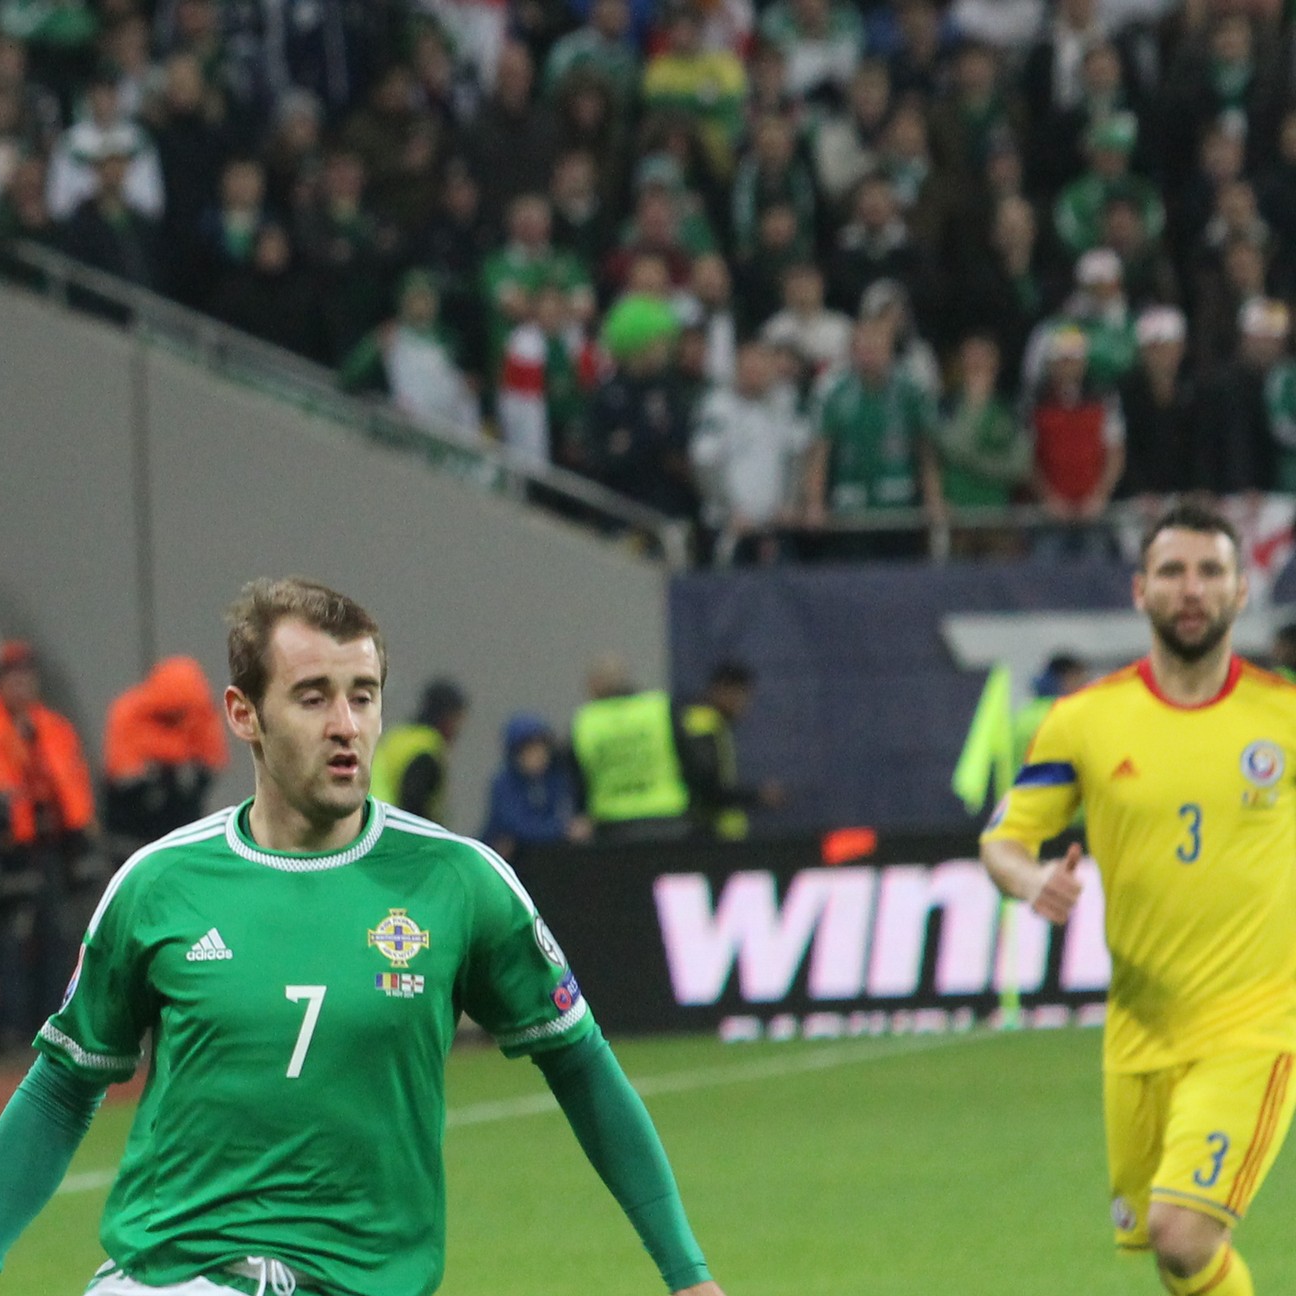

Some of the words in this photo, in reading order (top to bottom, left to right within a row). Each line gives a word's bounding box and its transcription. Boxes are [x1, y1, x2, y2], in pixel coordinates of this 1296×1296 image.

[1176, 803, 1202, 864] 3
[186, 949, 233, 961] adidas
[285, 985, 327, 1077] 7
[1194, 1132, 1229, 1188] 3
